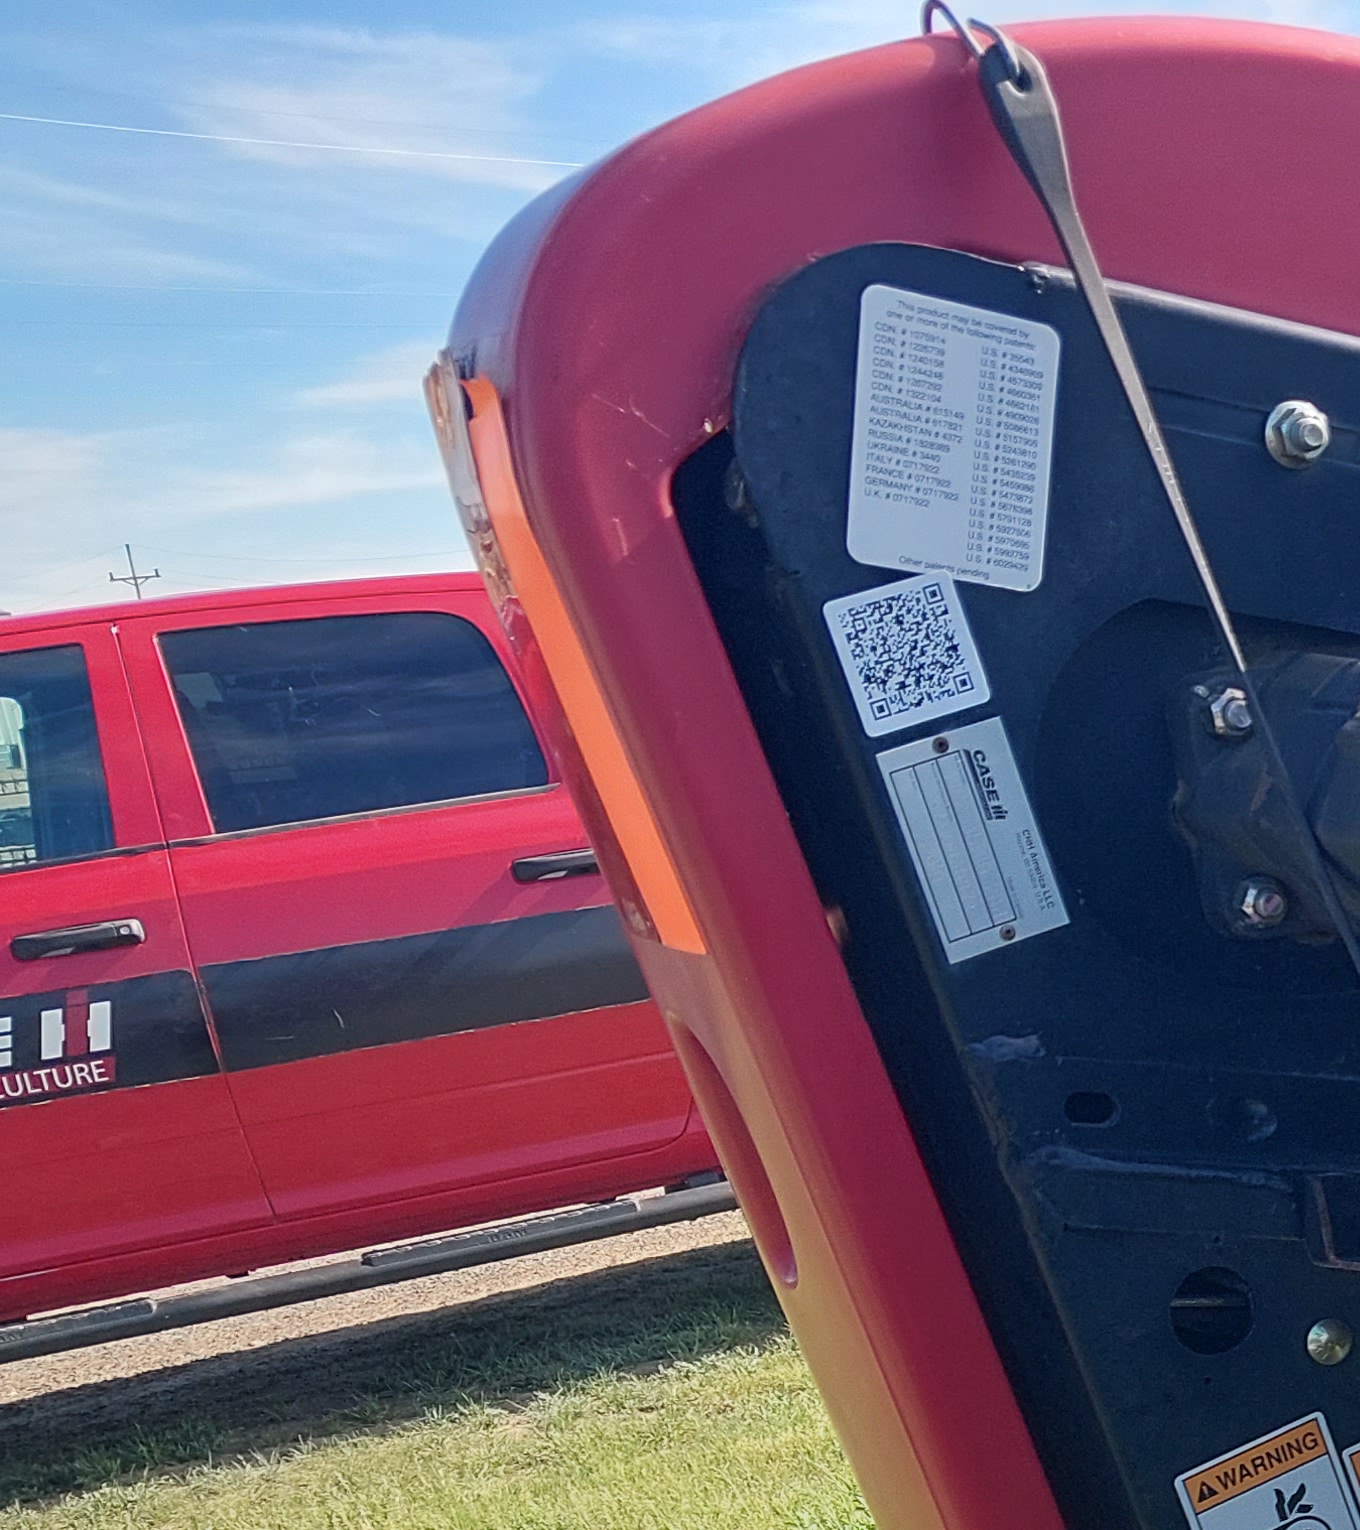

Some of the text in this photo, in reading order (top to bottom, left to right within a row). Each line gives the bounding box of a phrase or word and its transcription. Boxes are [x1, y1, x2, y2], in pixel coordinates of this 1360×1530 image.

[866, 453, 892, 464] ITALY
[866, 464, 904, 478] FRANCE
[865, 475, 913, 493] GERMANY
[973, 750, 1000, 802] CASE
[1043, 890, 1055, 909] LLC
[0, 1060, 109, 1098] ULTURE
[1216, 1432, 1318, 1490] WARNING
